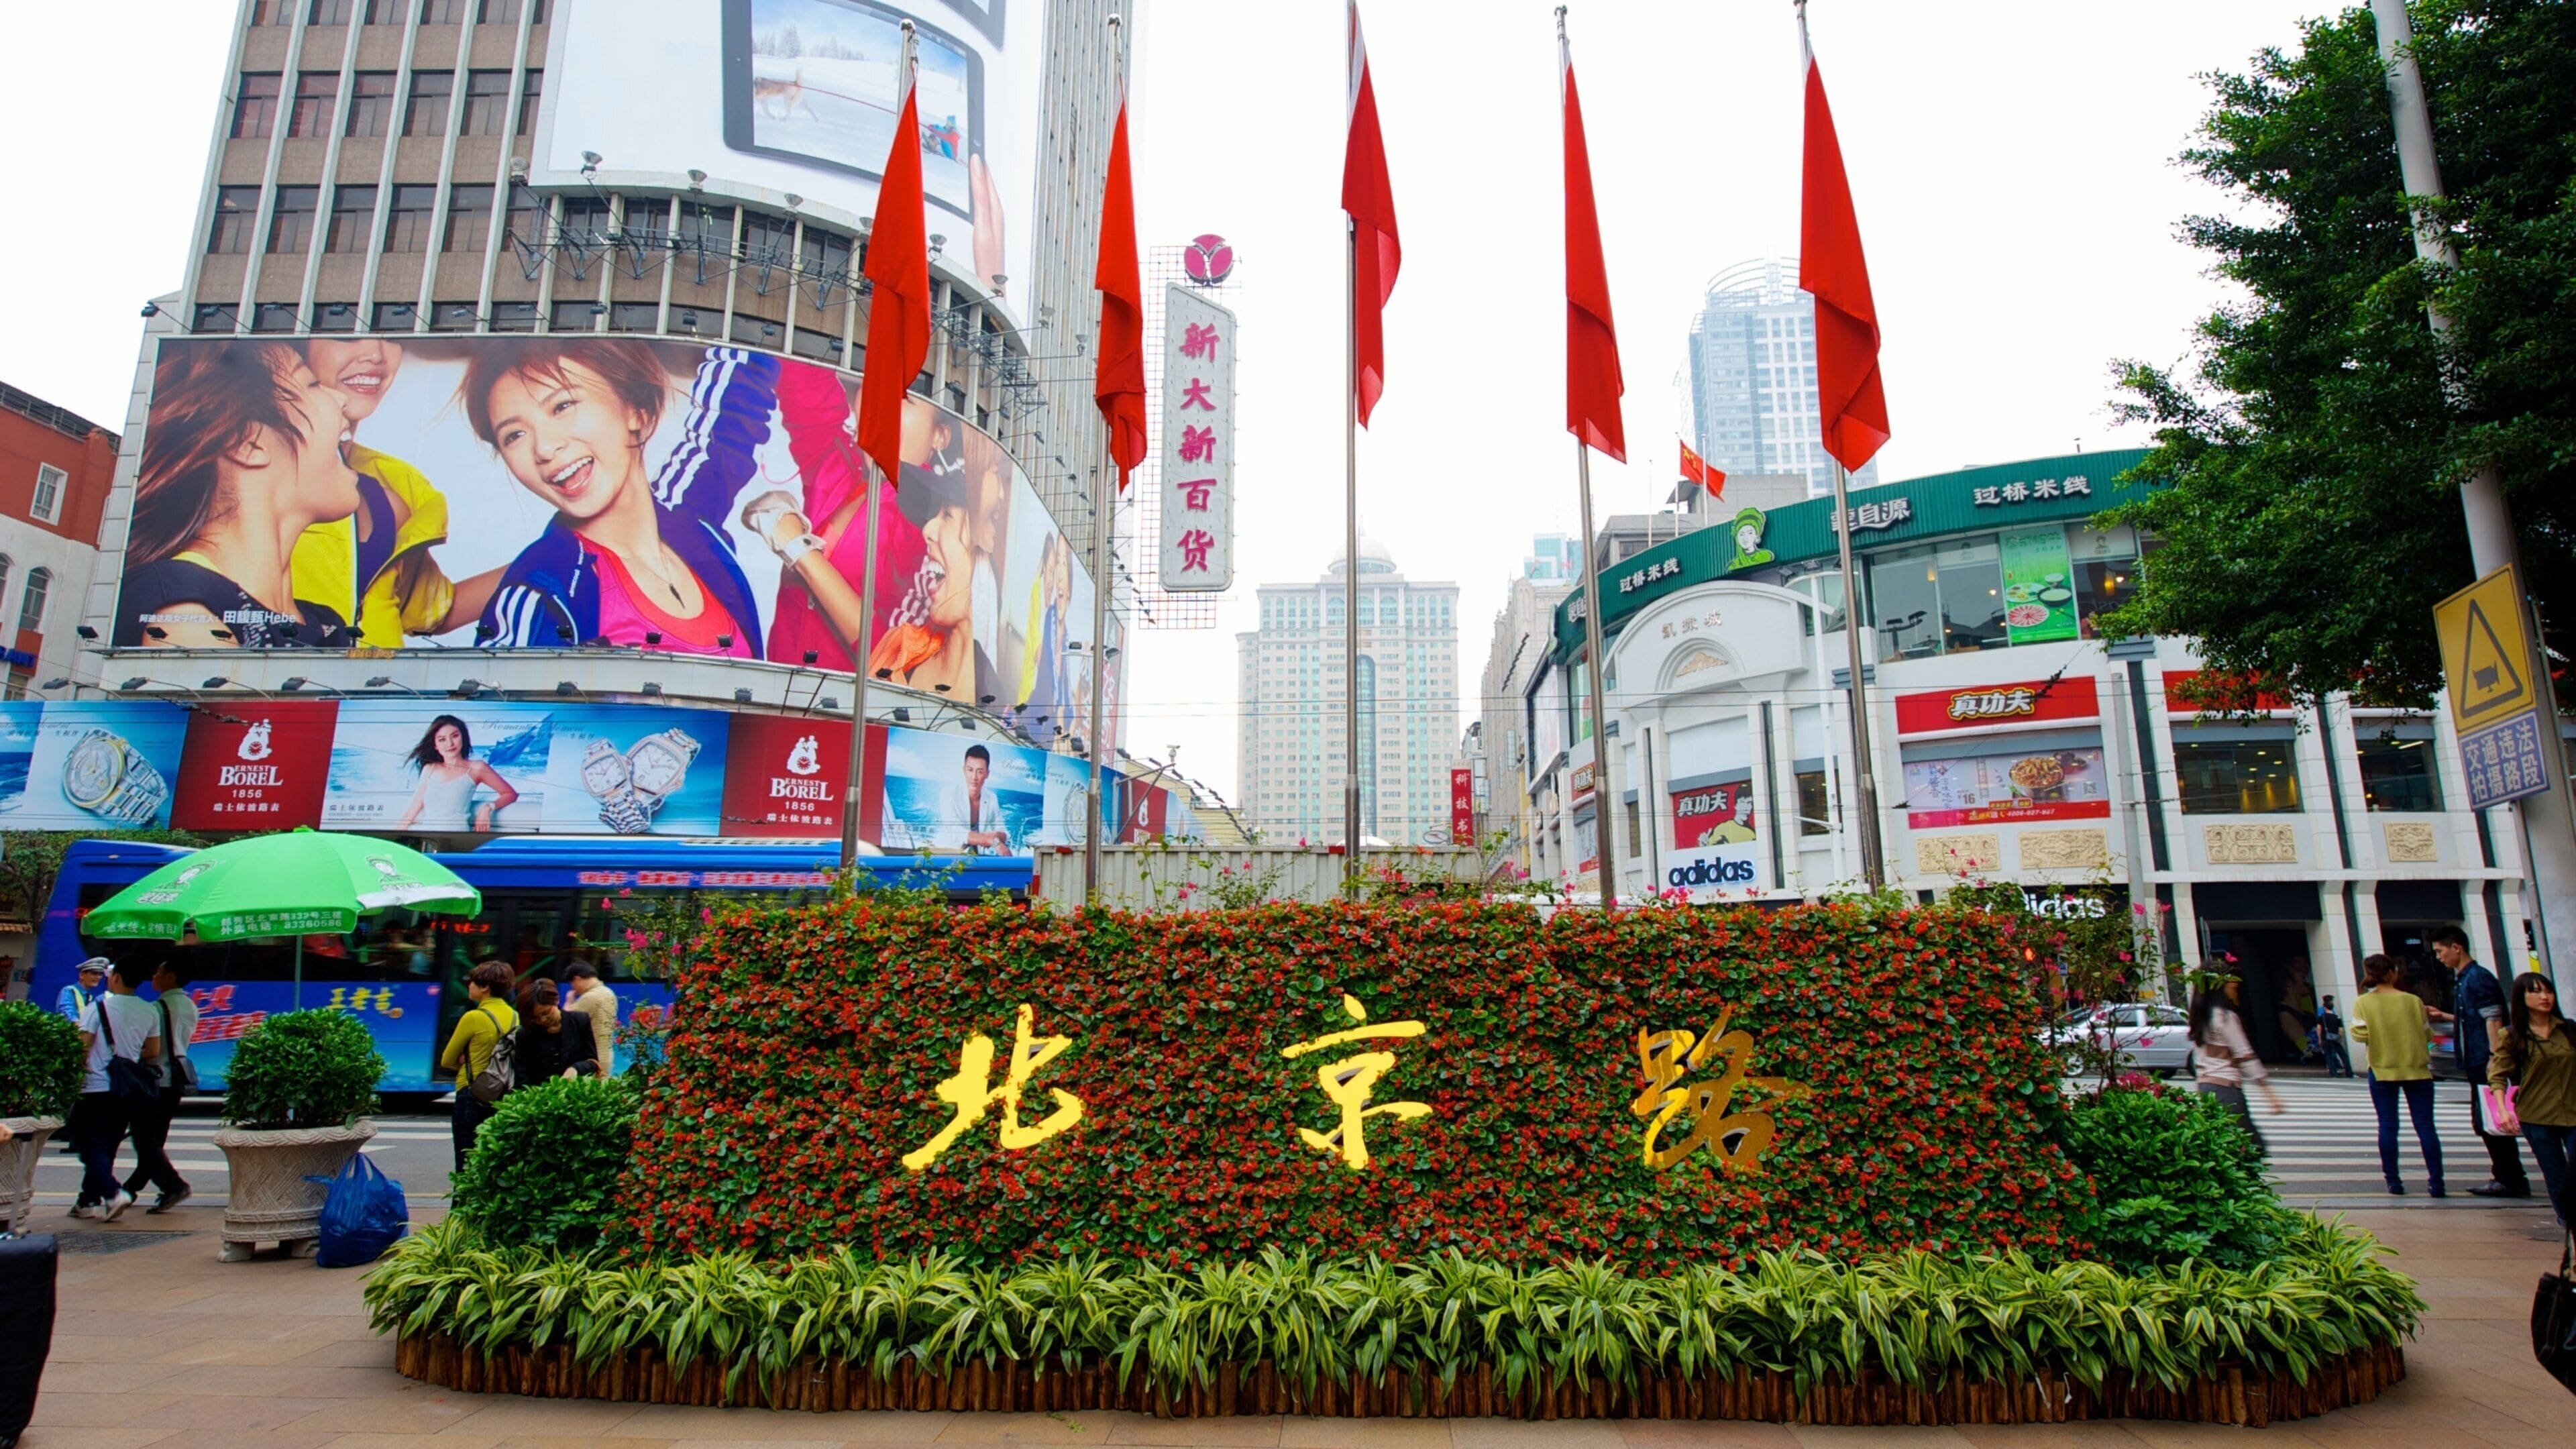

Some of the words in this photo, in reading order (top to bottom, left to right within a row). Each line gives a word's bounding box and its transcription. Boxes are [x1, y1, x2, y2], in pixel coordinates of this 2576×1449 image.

[1177, 322, 1221, 572] 新大新百货
[1974, 475, 2091, 505] 过桥米线
[1619, 557, 1680, 593] 过桥米线
[1951, 690, 2031, 717] 真功夫
[2465, 720, 2534, 771] 交通违法
[217, 766, 284, 786] BOREL
[769, 777, 835, 801] BOREL
[785, 778, 820, 786] ERNEST
[2471, 753, 2540, 802] 拍摄路段
[232, 789, 262, 798] 1856
[785, 801, 815, 812] 1856
[1677, 791, 1729, 818] 真功夫
[213, 803, 280, 812] 瑞士依波路表
[767, 812, 833, 826] 瑞士依波路表
[1668, 857, 1756, 887] adidas
[327, 987, 395, 1010] 王老吉
[902, 994, 1814, 1172] 北京路
